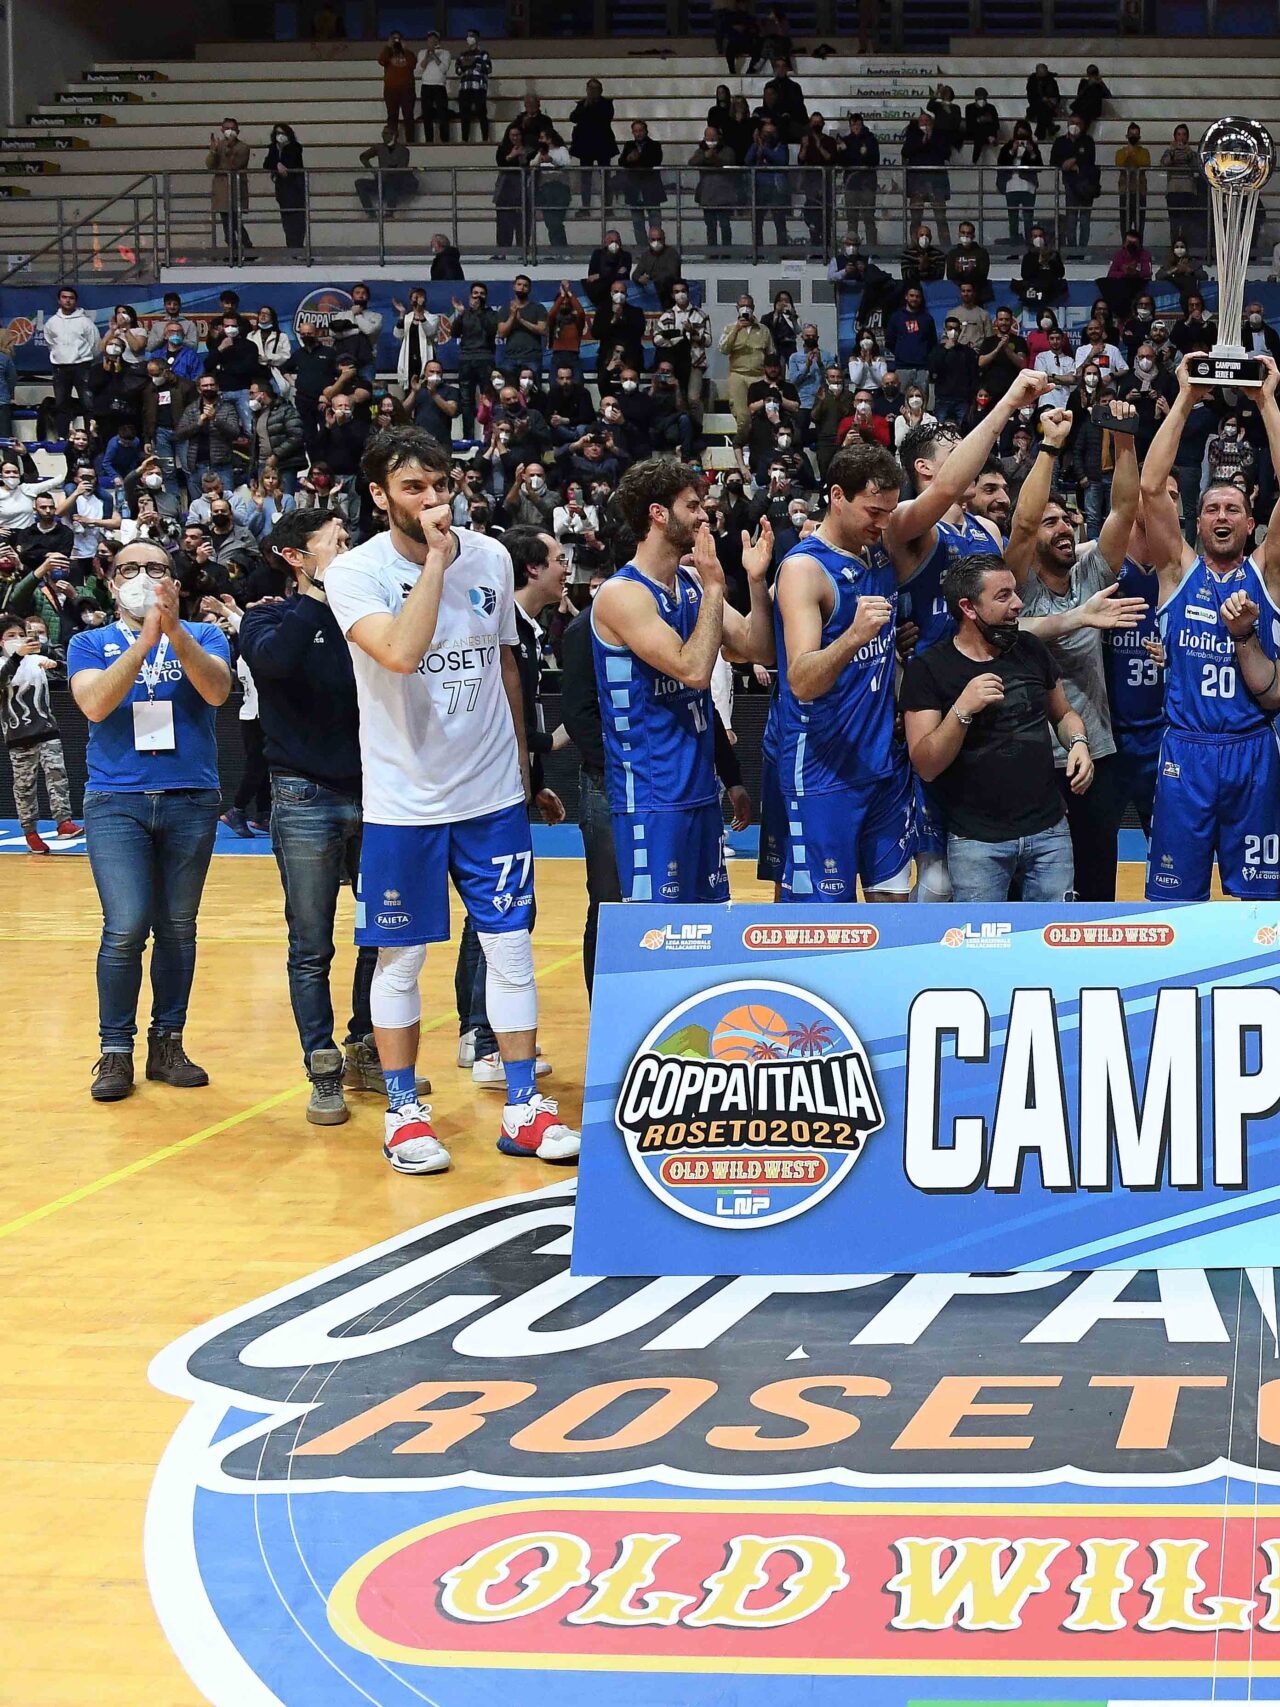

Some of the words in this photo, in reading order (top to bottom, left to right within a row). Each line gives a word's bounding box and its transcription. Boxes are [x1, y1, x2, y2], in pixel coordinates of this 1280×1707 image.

[1214, 370, 1229, 378] SERIE
[1215, 361, 1241, 370] CAMPIONI
[1179, 629, 1236, 654] Liofilch
[1127, 658, 1159, 687] 33
[1201, 663, 1236, 699] 20
[442, 677, 482, 715] 77
[1244, 834, 1279, 865] 20
[491, 850, 532, 892] 77
[1155, 875, 1179, 885] FAIETA
[820, 881, 845, 891] FAIETA
[377, 914, 409, 925] FAIETA
[666, 924, 713, 939] LNP
[750, 929, 783, 945] OLD
[784, 929, 827, 945] WILD
[827, 929, 872, 945] WEST
[966, 922, 1012, 938] LNP
[1049, 927, 1081, 943] OLD
[1083, 927, 1124, 943] WILD
[1124, 927, 1169, 943] WEST
[623, 1058, 748, 1124] COPPA
[758, 1057, 878, 1122] ITALIA
[642, 1119, 855, 1148] ROSETO2022
[669, 1160, 711, 1180] OLD
[712, 1160, 761, 1179] WILD
[763, 1159, 821, 1179] WEST
[716, 1197, 771, 1215] LNP
[435, 1529, 852, 1633] OLD
